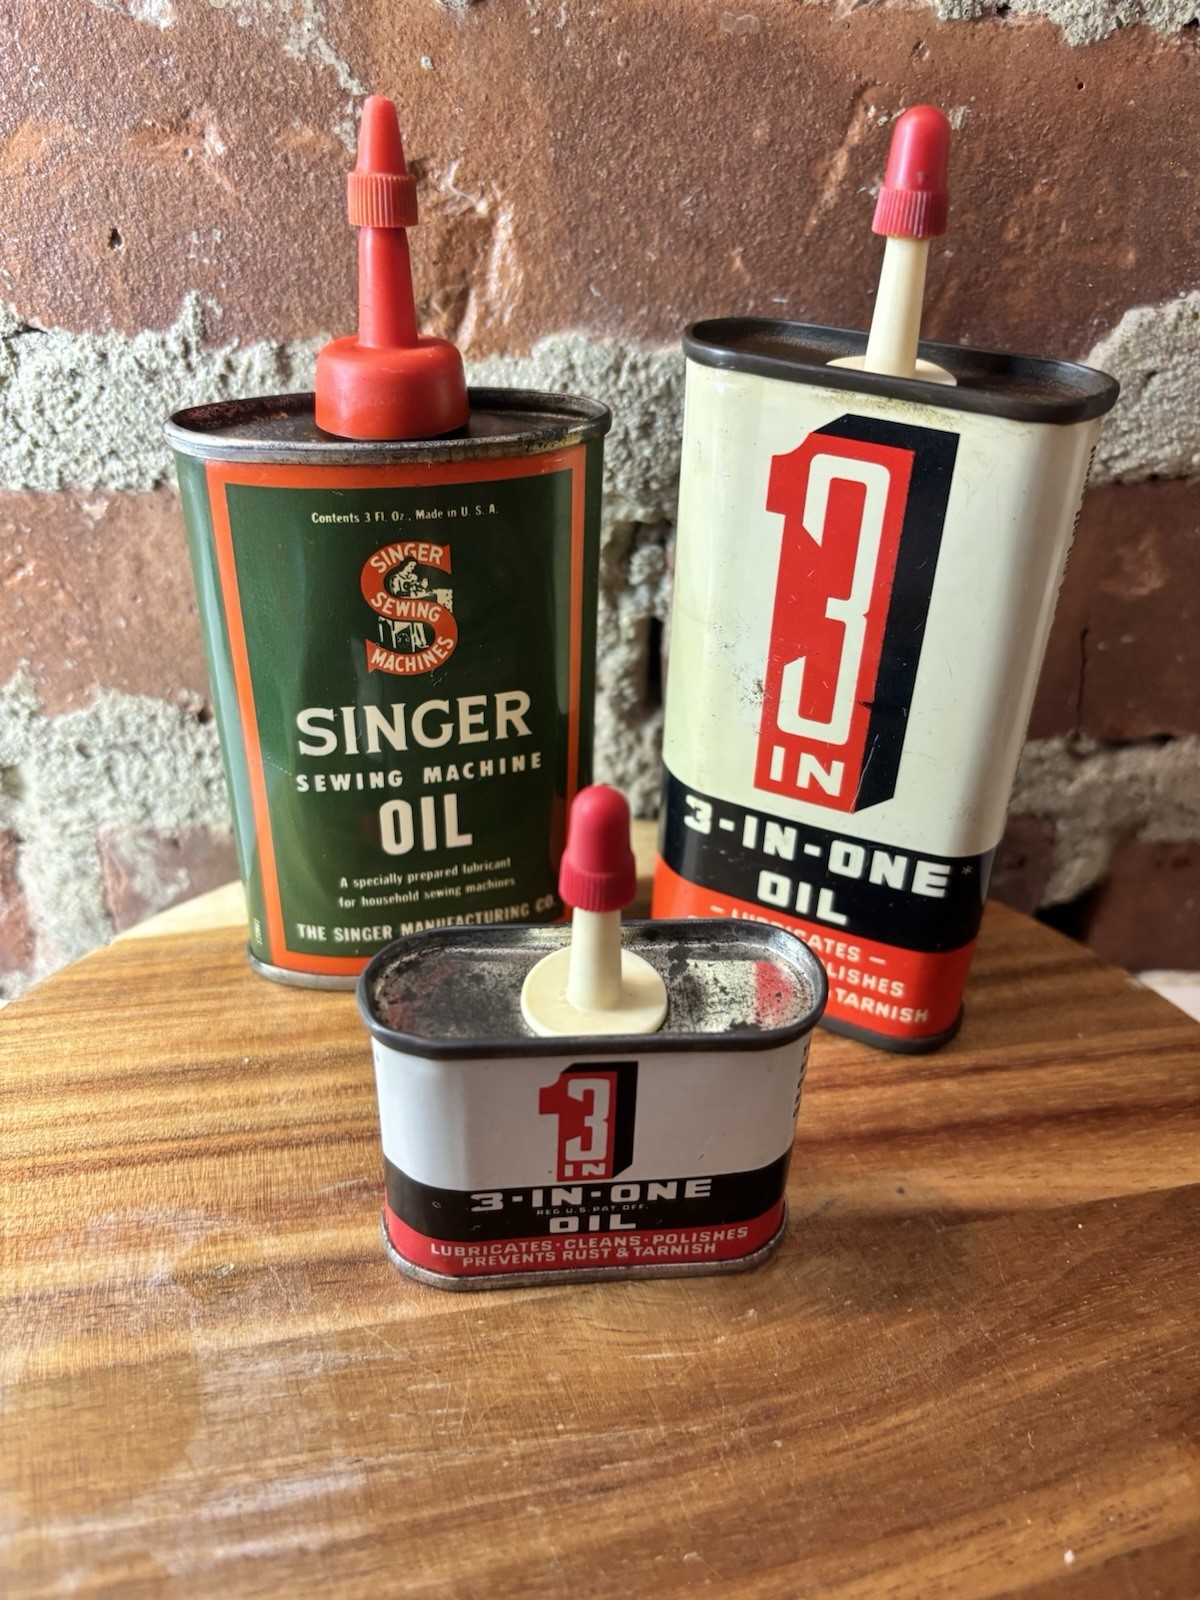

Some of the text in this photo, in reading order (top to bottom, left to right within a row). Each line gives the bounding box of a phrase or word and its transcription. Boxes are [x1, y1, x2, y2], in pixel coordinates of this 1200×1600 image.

[311, 512, 360, 524] Contents
[364, 512, 371, 523] 3
[415, 508, 444, 520] Made
[447, 507, 458, 518] in
[370, 543, 444, 573] SINGER
[371, 592, 441, 622] SEWING
[777, 453, 891, 746] 3
[371, 636, 454, 672] MACHINES
[296, 690, 533, 757] SINGER
[296, 752, 542, 793] SEWING MACHINE
[769, 745, 845, 798] IN
[379, 793, 473, 855] OIL
[683, 794, 952, 898] 3-IN-ONE
[340, 857, 511, 889] A specially prepared lubricant
[338, 877, 515, 908] for household sewing machines
[757, 869, 849, 926] OIL
[296, 922, 327, 942] THE
[333, 924, 393, 942] SINGER
[824, 960, 906, 998] LISHES
[835, 987, 929, 1023] TARNISH
[565, 1077, 611, 1161] 3
[564, 1162, 606, 1178] IN
[470, 1178, 713, 1212] 3-IN-ONE
[549, 1214, 637, 1234] OIL
[431, 1226, 749, 1258] LUBRICATES CLEANS POLISHES
[463, 1242, 717, 1268] PREVENTS RUST & TARNISH
